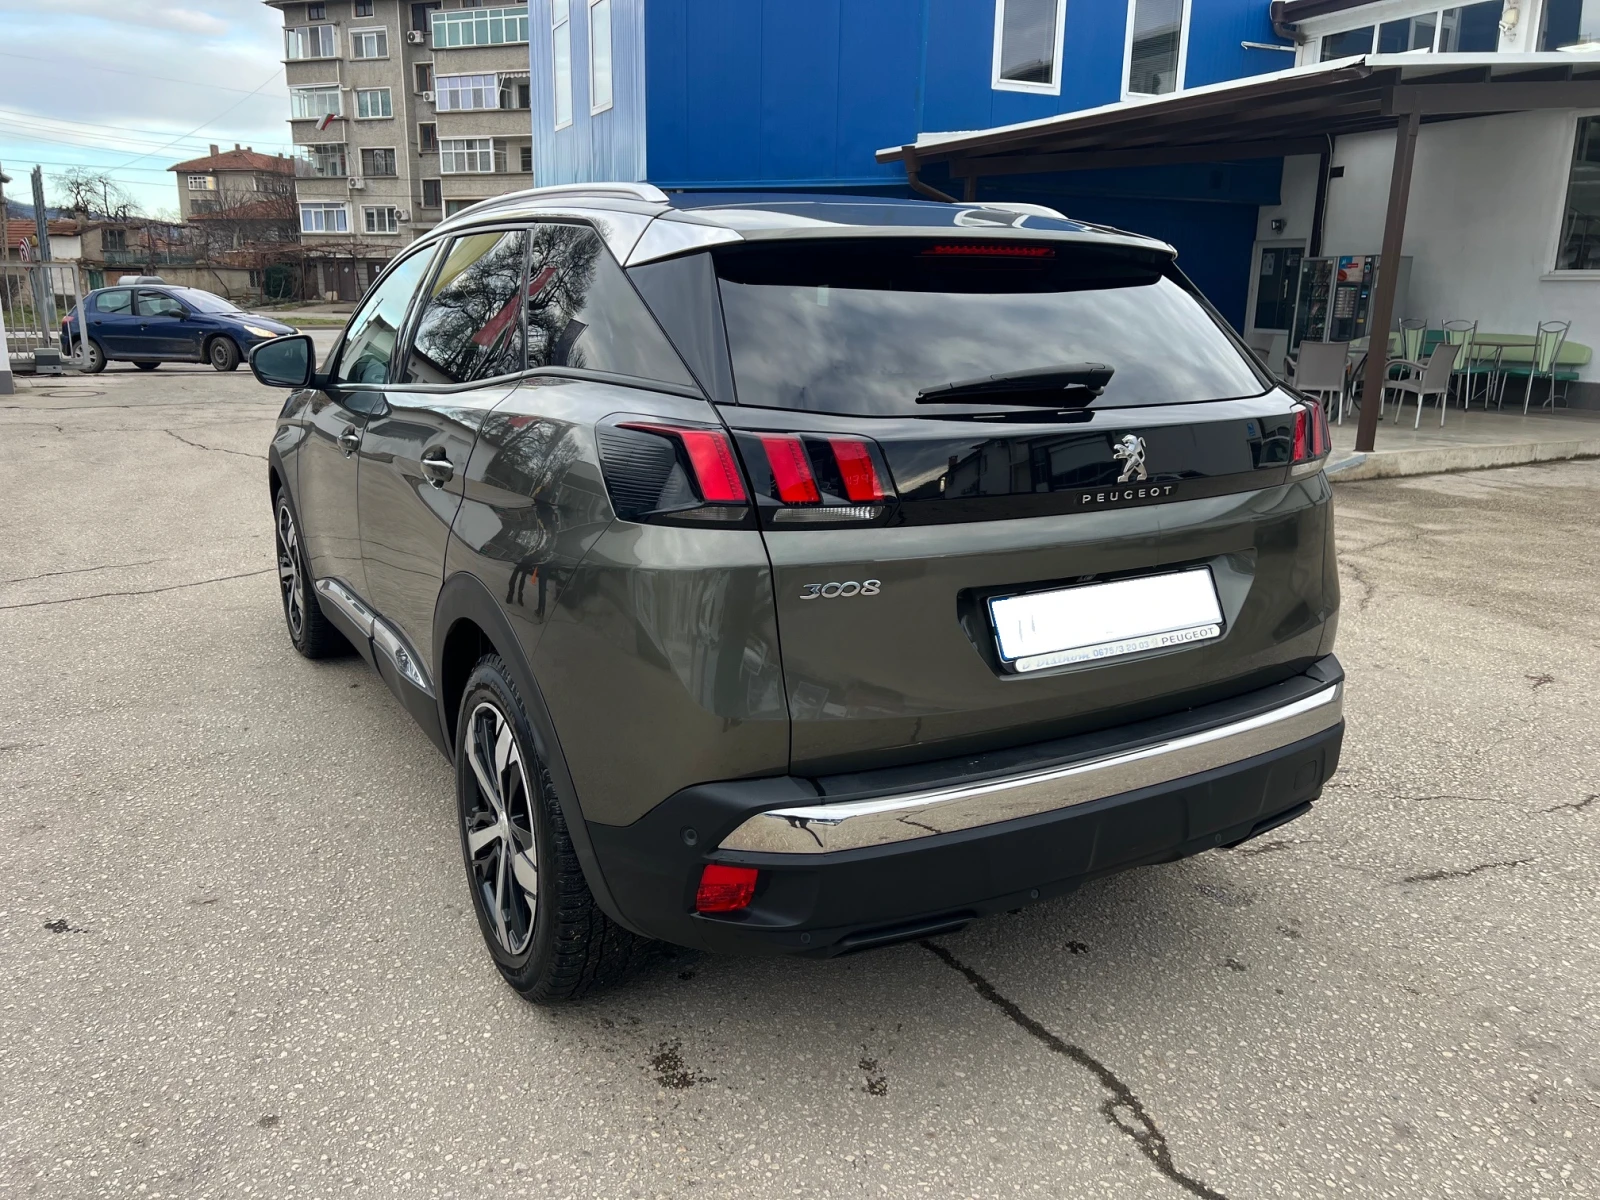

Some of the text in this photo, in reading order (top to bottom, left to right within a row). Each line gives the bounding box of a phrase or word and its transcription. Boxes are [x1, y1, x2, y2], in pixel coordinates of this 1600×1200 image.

[1082, 486, 1172, 504] PEUGEOT
[799, 579, 881, 600] 3008
[1161, 627, 1214, 645] PEUGEOT
